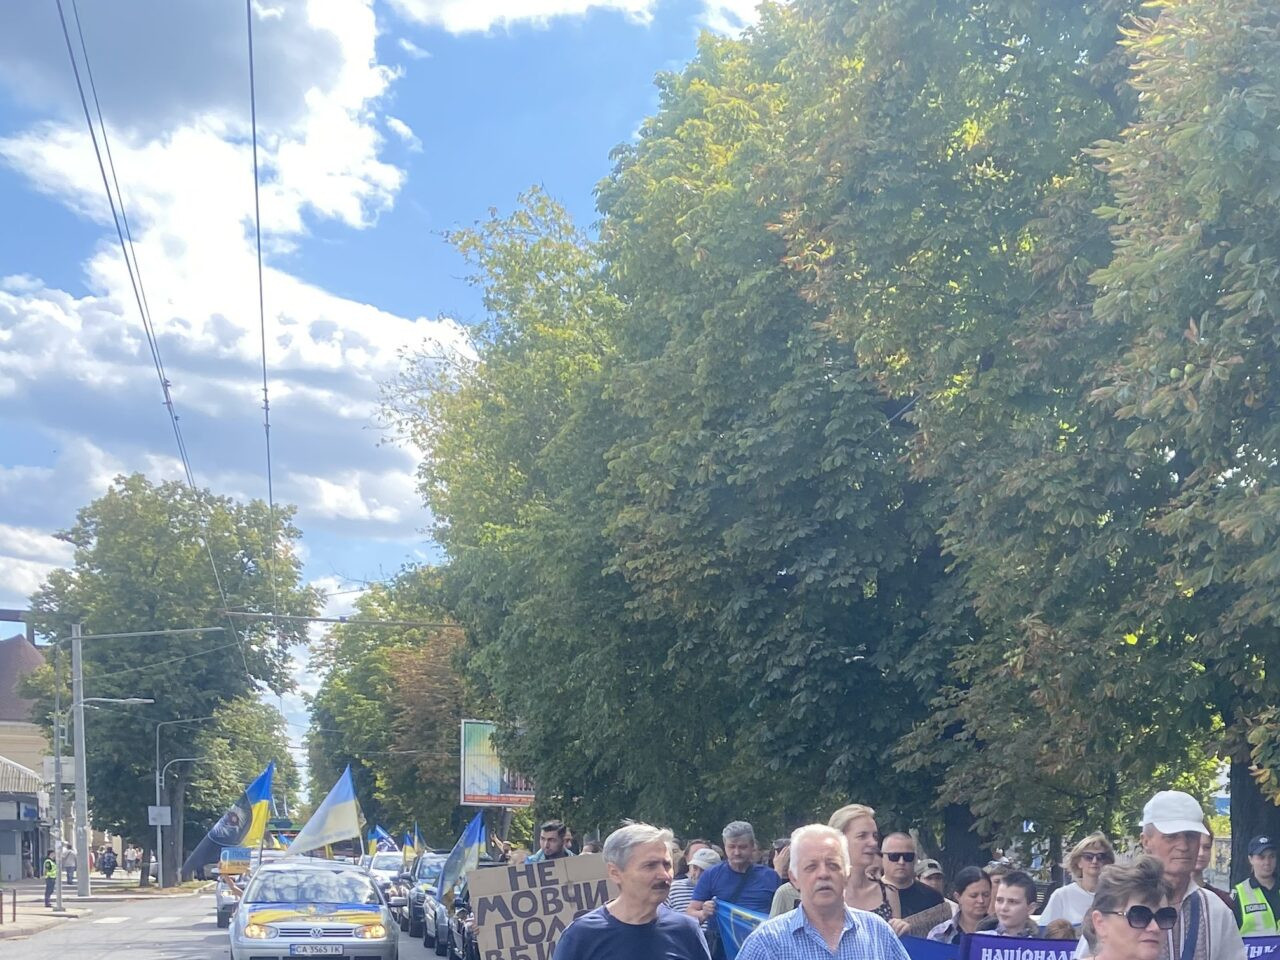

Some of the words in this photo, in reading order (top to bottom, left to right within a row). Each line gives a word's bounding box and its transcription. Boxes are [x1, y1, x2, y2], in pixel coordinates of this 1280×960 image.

[507, 861, 559, 891] НЕ
[477, 880, 610, 926] МОВЧИ
[495, 909, 591, 949] ПОЛ
